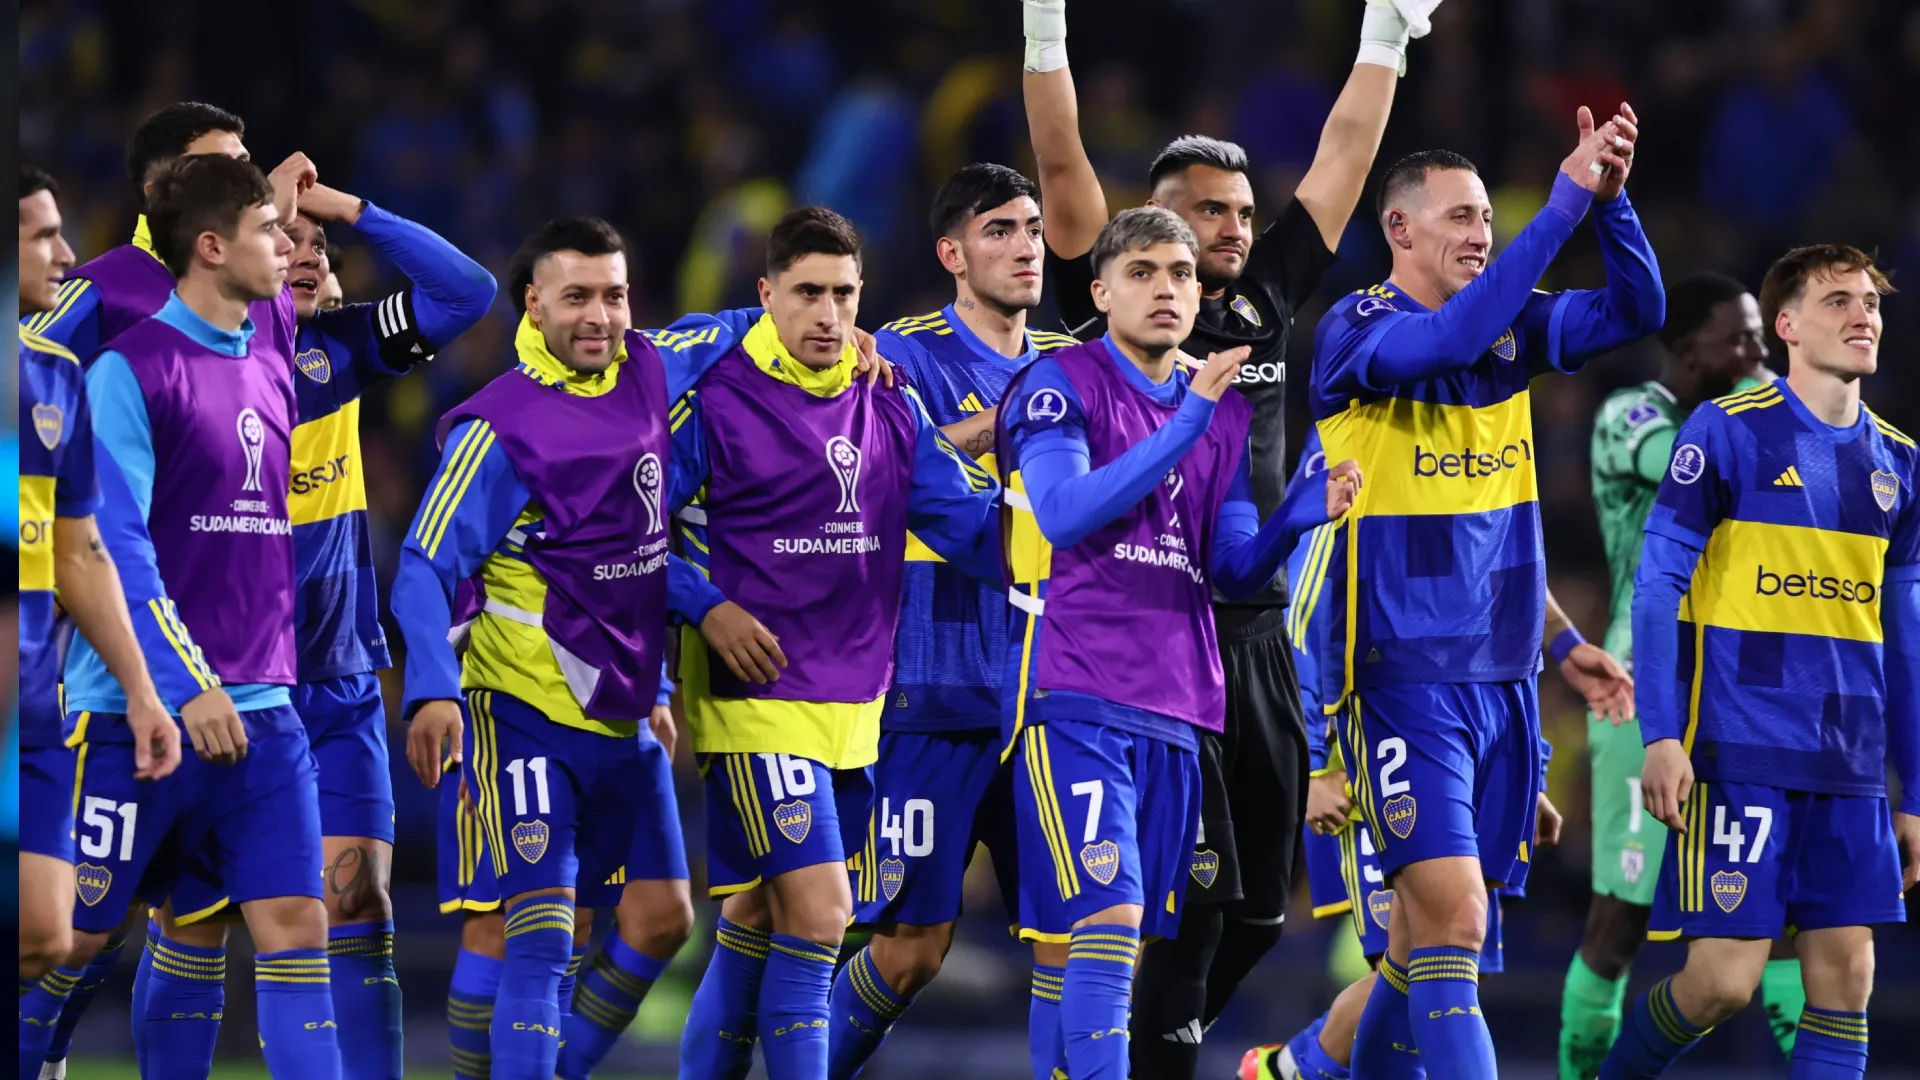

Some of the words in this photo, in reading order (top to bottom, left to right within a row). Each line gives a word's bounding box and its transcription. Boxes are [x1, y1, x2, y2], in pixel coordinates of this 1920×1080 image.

[302, 358, 326, 373] CABJ
[190, 514, 292, 536] SUDAMERICANA
[1756, 564, 1880, 606] betsso
[757, 753, 816, 801] 16
[1376, 737, 1411, 798] 2
[505, 756, 550, 816] 11
[1070, 779, 1104, 843] 7
[1388, 806, 1413, 823] CABJ
[1625, 777, 1642, 834] 1
[80, 795, 138, 861] 51
[780, 813, 807, 828] CABJ
[881, 797, 934, 857] 40
[517, 833, 546, 846] CABJ
[1712, 805, 1773, 863] 47
[1086, 849, 1115, 867] CABJ
[1191, 861, 1216, 871] CABJ
[78, 875, 106, 889] CABJ
[883, 872, 901, 882] CABJ
[1715, 884, 1743, 894] CABJ
[1372, 902, 1391, 912] CAB
